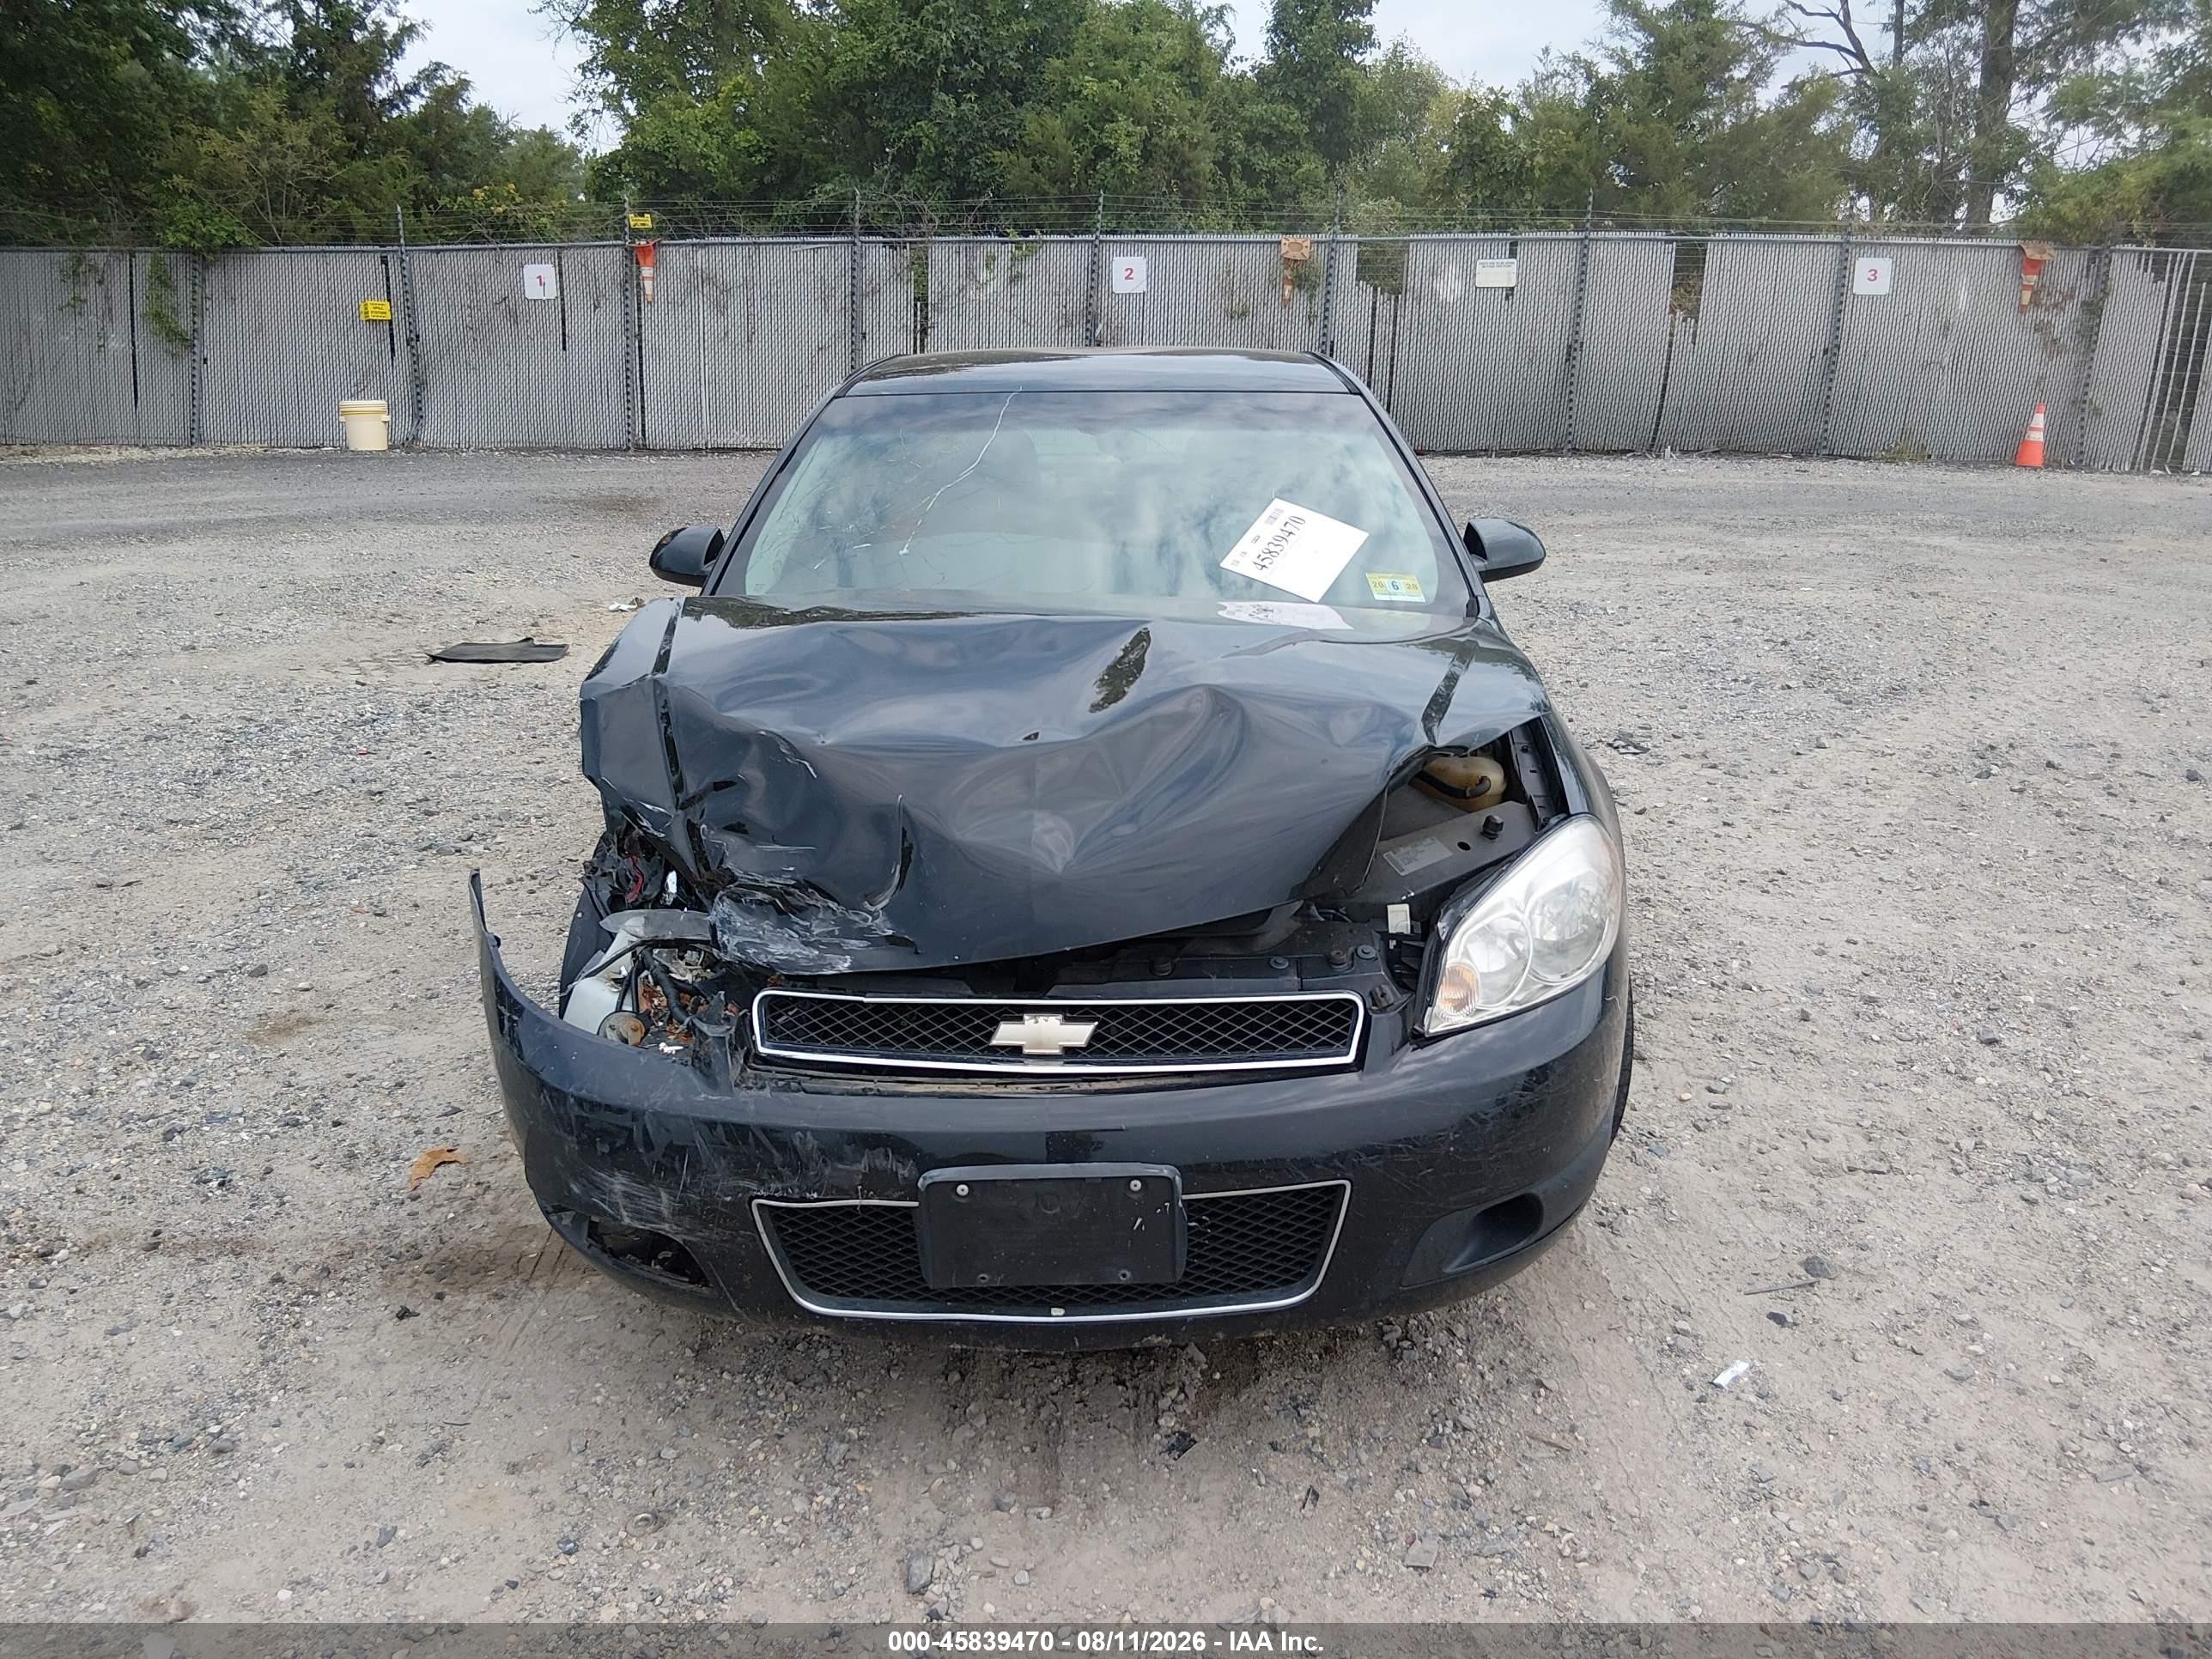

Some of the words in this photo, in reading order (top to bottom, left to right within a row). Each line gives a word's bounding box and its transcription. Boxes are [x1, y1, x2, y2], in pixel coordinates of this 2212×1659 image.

[536, 275, 543, 287] 1
[1124, 267, 1134, 281] 2
[1867, 268, 1878, 282] 3
[1252, 515, 1306, 571] 45839470
[1390, 580, 1400, 591] 6
